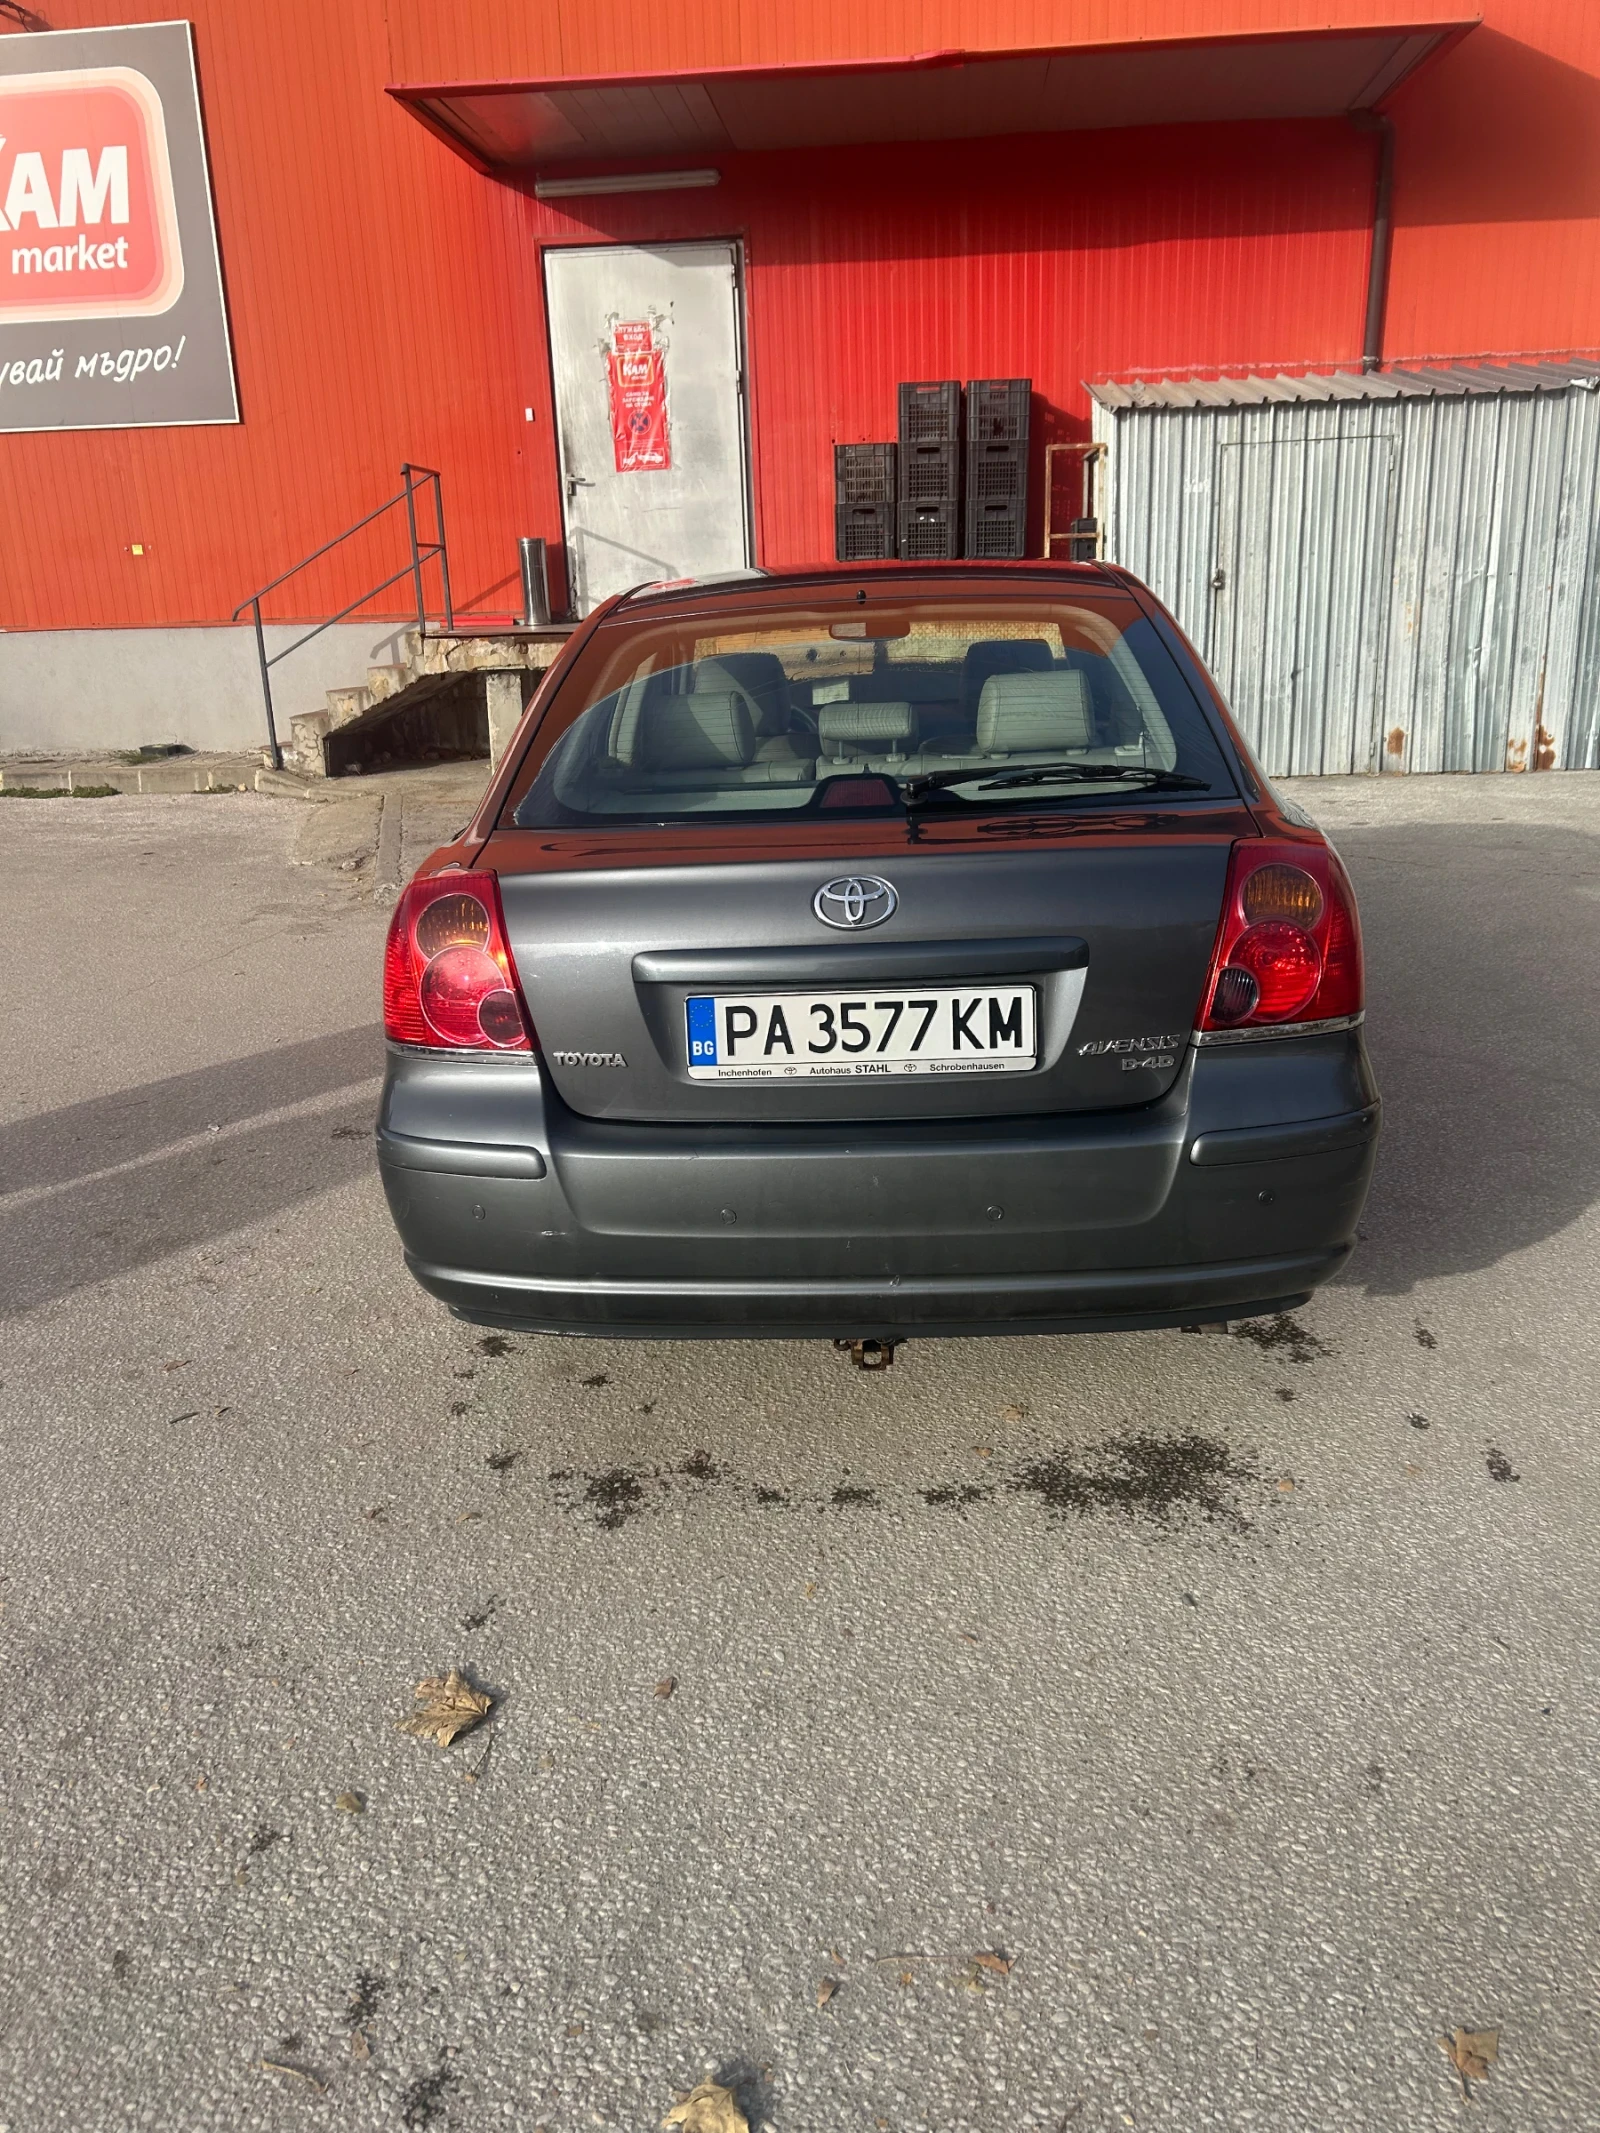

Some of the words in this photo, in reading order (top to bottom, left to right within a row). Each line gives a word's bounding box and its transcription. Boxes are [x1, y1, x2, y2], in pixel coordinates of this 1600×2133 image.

[0, 137, 129, 231] AM
[12, 233, 129, 274] market
[74, 335, 186, 382] мъдро!
[725, 1005, 795, 1057] PA
[808, 1000, 937, 1054] 3577
[952, 997, 1023, 1050] KM
[692, 1040, 714, 1056] BG
[1077, 1034, 1180, 1056] AVENSIS
[552, 1051, 628, 1068] TOYOTA
[718, 1069, 772, 1077] Inchenhofen
[809, 1066, 852, 1075] Autohaus
[855, 1064, 892, 1074] STAHL
[929, 1062, 1005, 1072] Schrobenhausen
[1121, 1055, 1175, 1071] D-4D
